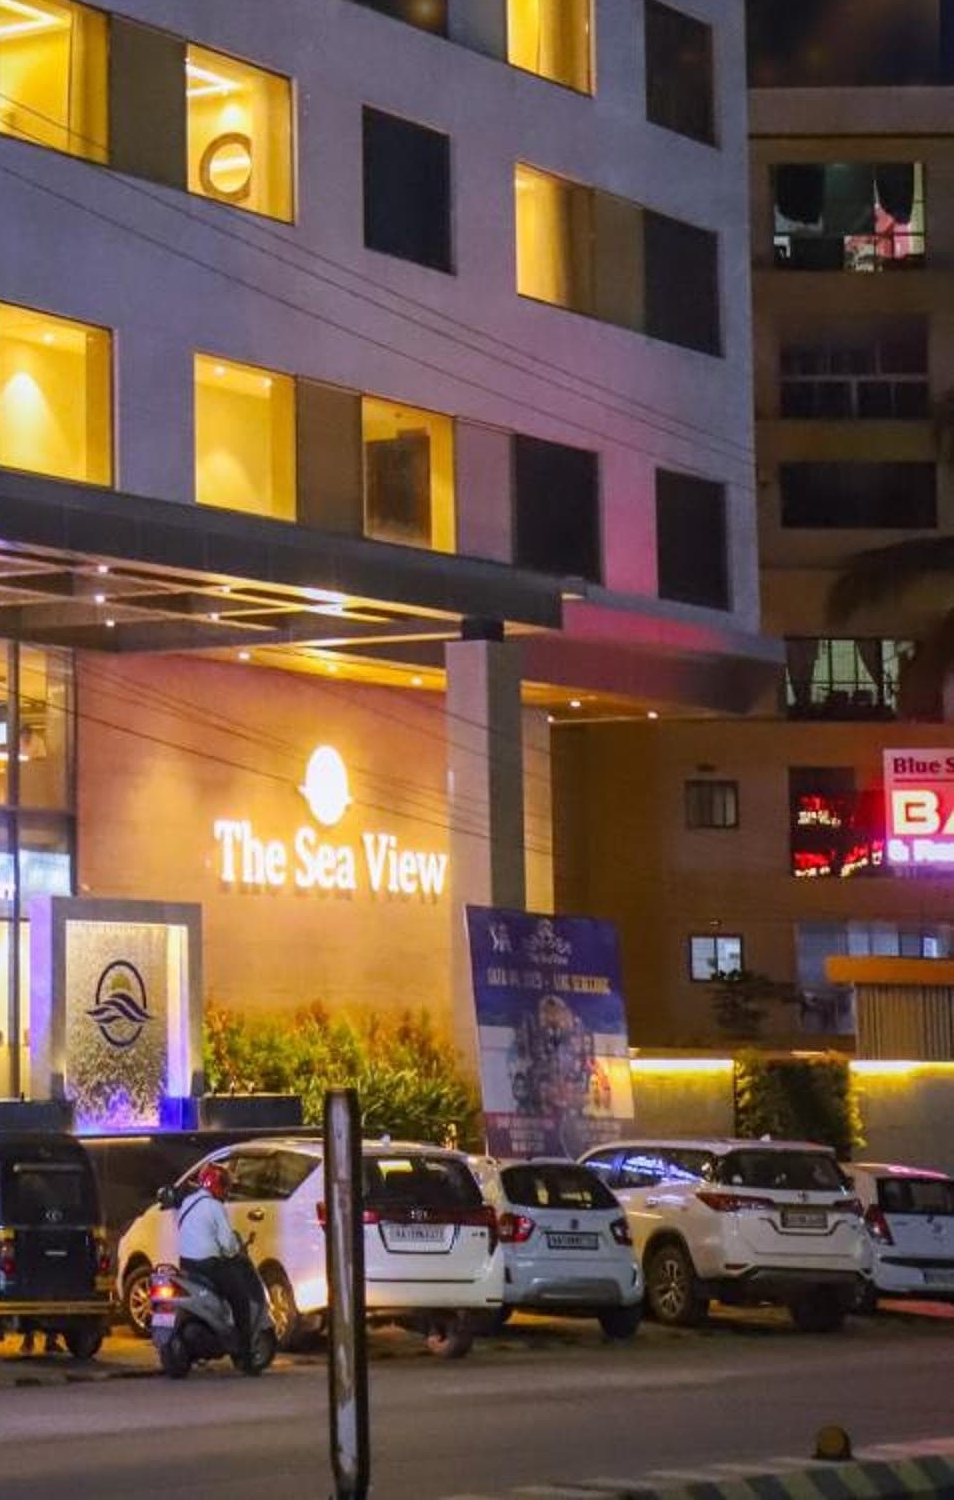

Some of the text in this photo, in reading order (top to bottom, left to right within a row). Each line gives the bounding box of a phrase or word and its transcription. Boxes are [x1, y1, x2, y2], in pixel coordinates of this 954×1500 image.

[893, 757, 941, 774] Blue
[891, 789, 954, 836] B
[214, 819, 449, 896] The Sea View
